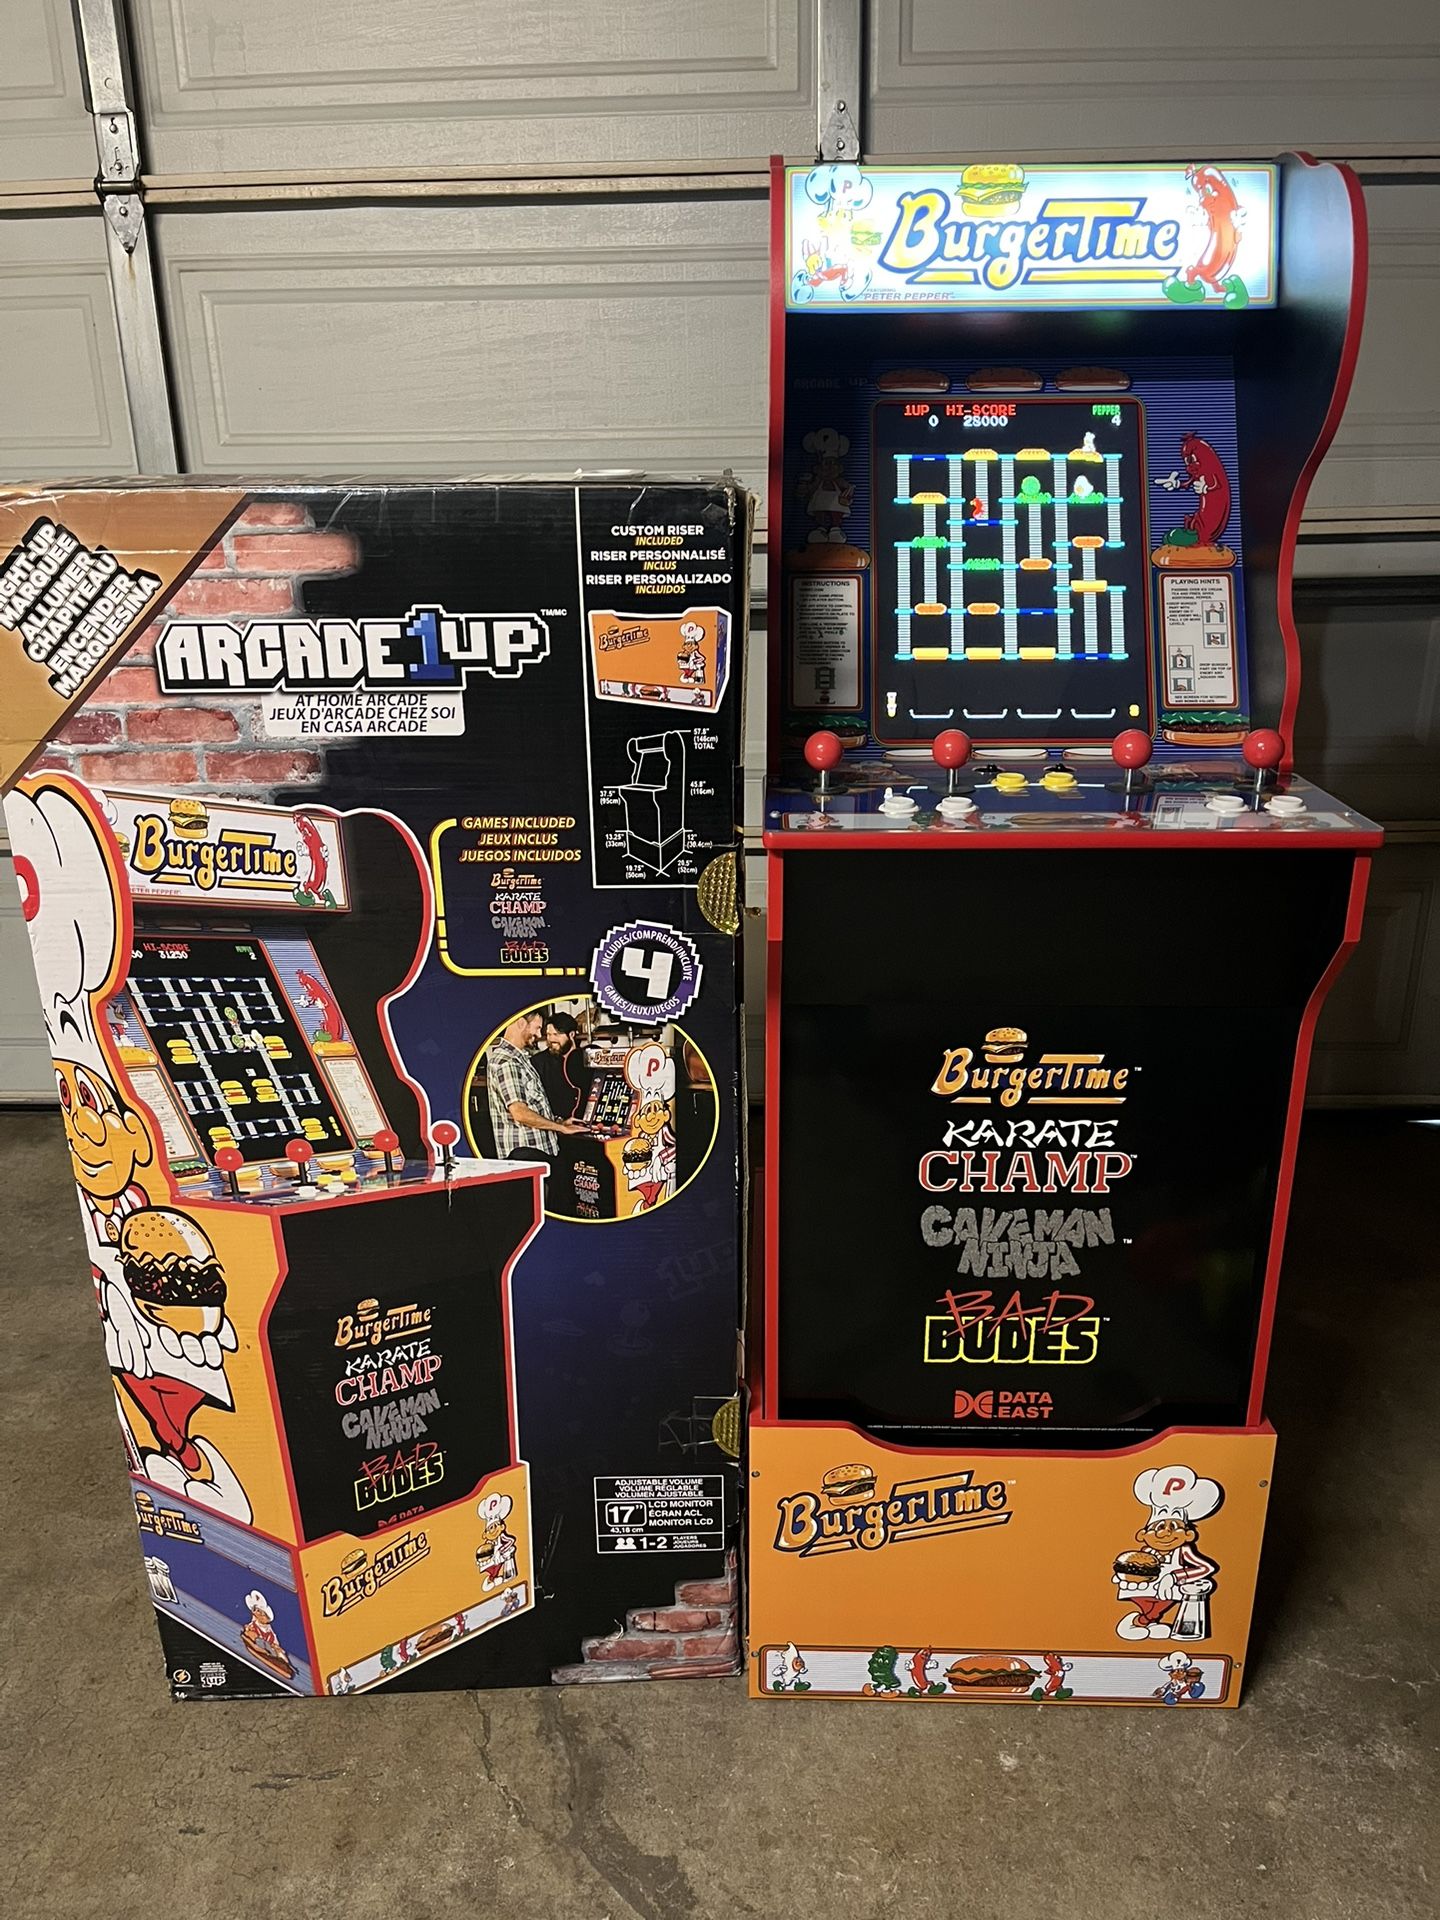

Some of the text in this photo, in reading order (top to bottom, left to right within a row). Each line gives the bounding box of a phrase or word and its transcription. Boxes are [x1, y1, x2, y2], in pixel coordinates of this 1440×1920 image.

[879, 188, 1182, 290] BurgerTime
[905, 405, 1121, 416] 1UP HI-SCORE PEPPER
[1111, 415, 1121, 427] 4
[611, 525, 704, 537] CUSTOM RISER
[635, 536, 684, 546] INCLUDED
[0, 523, 57, 607] IGHT-UP
[590, 547, 726, 561] RISER PERSONNALISÉ
[643, 561, 677, 570] INCLUS
[0, 532, 79, 629] MARQUEE
[586, 573, 732, 585] RISER PERSONALIZADO
[635, 585, 686, 594] INCLUIDOS
[20, 551, 96, 643] ALLUMER
[28, 553, 118, 662] CHAPITEAU
[50, 573, 136, 674] ENCENDER
[54, 575, 162, 698] MARQUESINA
[599, 626, 650, 651] BurgerTime
[269, 707, 456, 721] JEUX D'ARCADE CHEZ SOI
[295, 694, 428, 706] AT HOME ARCADE
[300, 720, 428, 733] EN CASA ARCADE
[462, 817, 576, 829] GAMES INCLUDED
[478, 834, 558, 845] JEUX INCLUS
[131, 813, 299, 891] BurgerTime
[459, 850, 582, 862] JUEGOS INCLUIDOS
[491, 873, 542, 889] BurgerTime
[495, 892, 541, 901] KARATE
[489, 901, 547, 914] CHAMP
[601, 930, 692, 981] INCLUDES/COMPREND/INCLUYE
[621, 947, 674, 999] 4
[604, 985, 680, 1015] GAMES/JEUX/JUEGOS
[931, 1047, 1129, 1107] BurgerTime
[942, 1120, 1119, 1148] KARATE
[919, 1151, 1133, 1193] CHAMP
[920, 1205, 1116, 1249] CAVEMAN
[957, 1237, 1081, 1281] NINJA
[334, 1303, 432, 1349] BurgerTime
[936, 1289, 1095, 1341] BAD
[924, 1316, 1100, 1365] DUDES
[345, 1338, 431, 1377] KARATE
[335, 1355, 442, 1407] CHAMP
[999, 1391, 1053, 1404] DATA
[341, 1388, 442, 1440] CAVEMAN
[998, 1406, 1054, 1418] EAST
[365, 1414, 428, 1450] NINJA
[354, 1452, 444, 1511] DUDES
[358, 1442, 438, 1488] BAD
[399, 1505, 425, 1520] DATA
[648, 1509, 681, 1517] ÉCRAN
[670, 1500, 713, 1508] MONITOR
[774, 1470, 1014, 1558] BurgerTime
[134, 1503, 203, 1543] urgerTime
[639, 1536, 667, 1549] 1-2
[320, 1532, 431, 1616] BurgerTime
